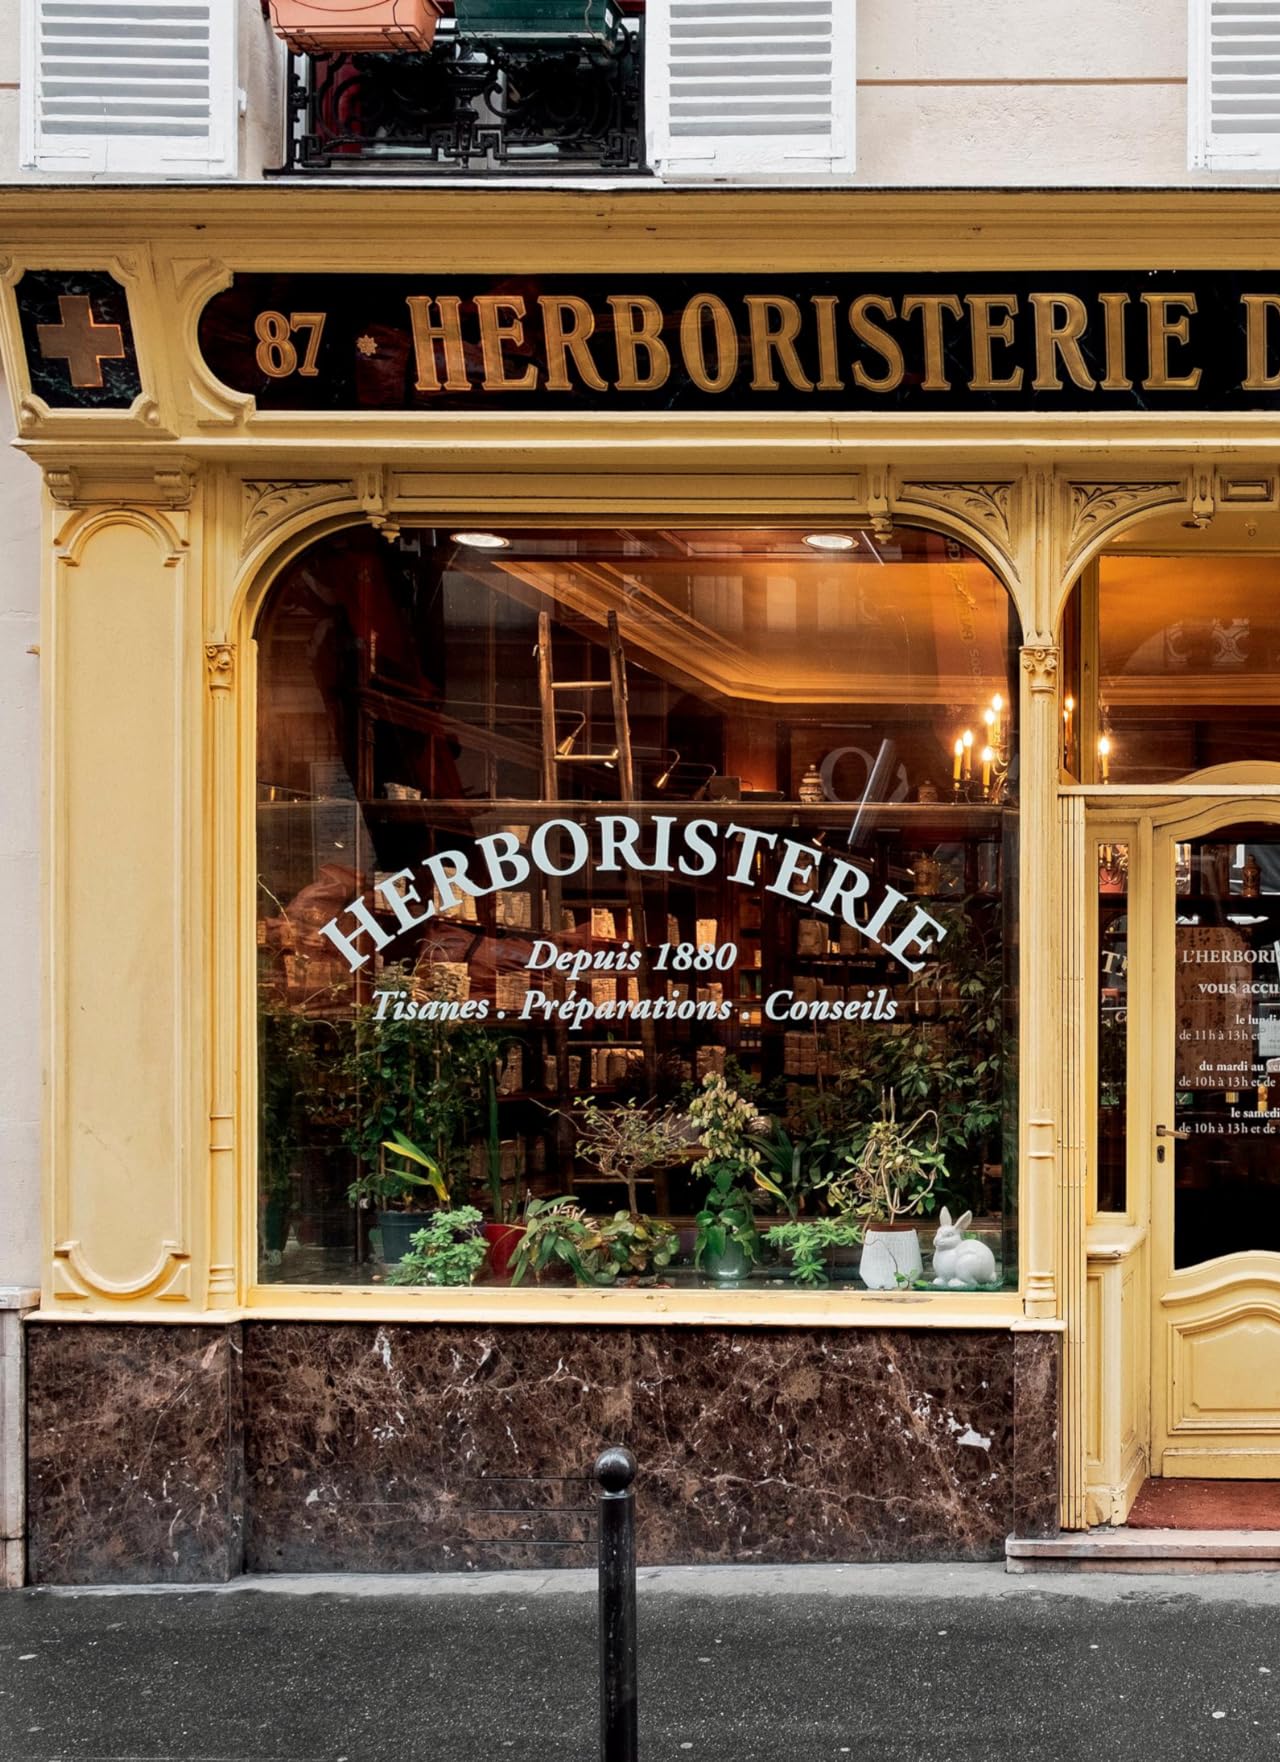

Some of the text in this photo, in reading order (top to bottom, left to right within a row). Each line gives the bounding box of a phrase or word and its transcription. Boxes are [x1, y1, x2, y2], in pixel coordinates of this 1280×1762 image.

[253, 311, 327, 378] 87
[406, 292, 1203, 393] HERBORISTERIE
[317, 814, 948, 974] HERBORISTERIE
[523, 940, 738, 980] Depuis 1880
[1199, 982, 1236, 994] vous
[370, 987, 899, 1030] Tisanes Préparations Conseils
[1235, 1014, 1245, 1025] le
[1179, 1030, 1192, 1041] de
[1218, 1030, 1224, 1041] à
[1199, 1061, 1214, 1072] du
[1216, 1061, 1248, 1072] mardi
[1251, 1063, 1264, 1072] au
[1178, 1076, 1192, 1087] de
[1218, 1076, 1224, 1087] à
[1251, 1076, 1261, 1087] et
[1263, 1076, 1276, 1087] de
[1231, 1107, 1280, 1118] le samedi
[1178, 1122, 1192, 1134] de
[1218, 1122, 1224, 1134] à
[1251, 1122, 1261, 1134] et
[1263, 1122, 1276, 1134] de
